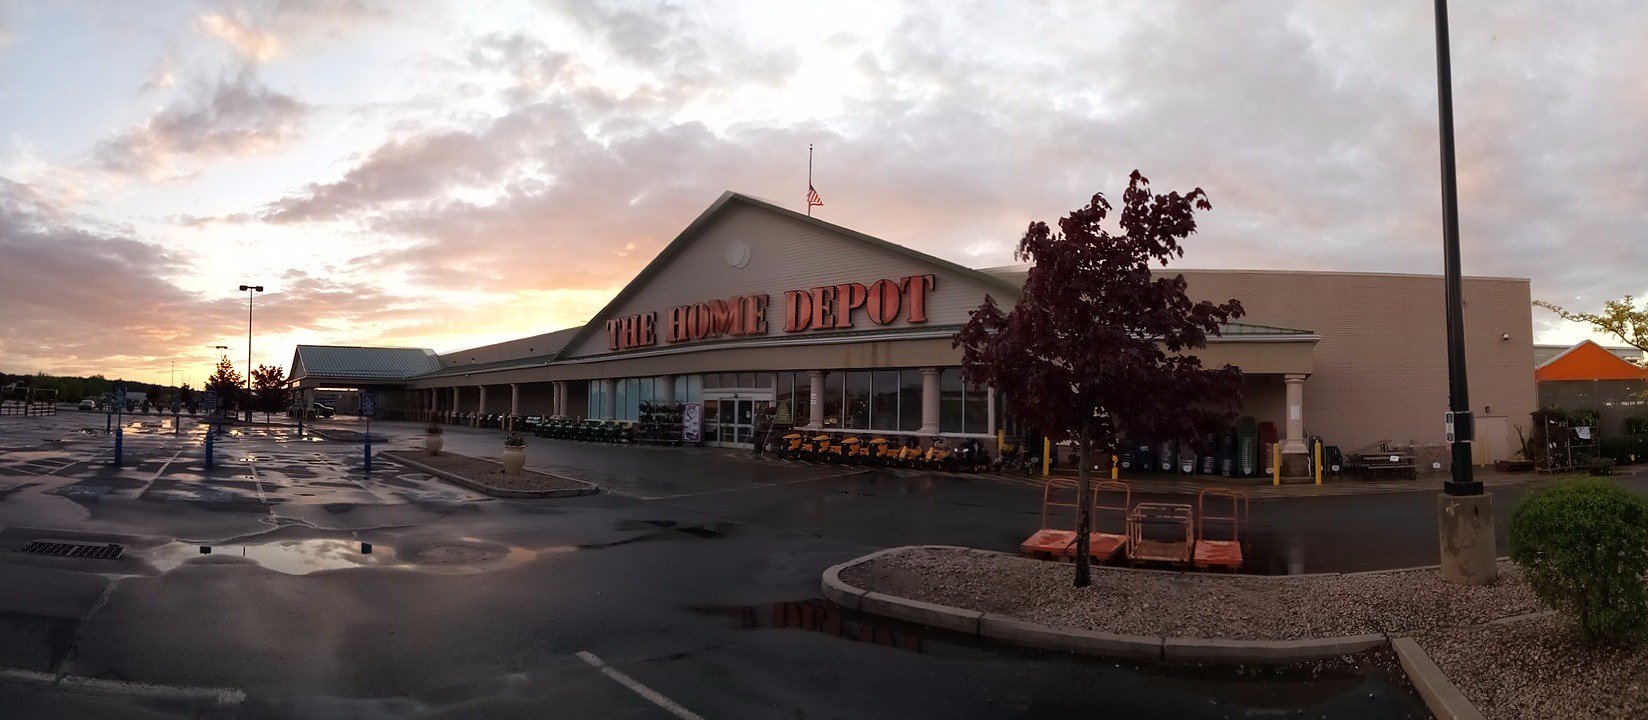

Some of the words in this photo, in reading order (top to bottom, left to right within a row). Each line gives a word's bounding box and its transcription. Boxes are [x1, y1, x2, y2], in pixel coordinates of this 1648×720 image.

[606, 311, 657, 350] THE
[665, 293, 770, 343] HOME
[783, 273, 935, 332] DEPOT
